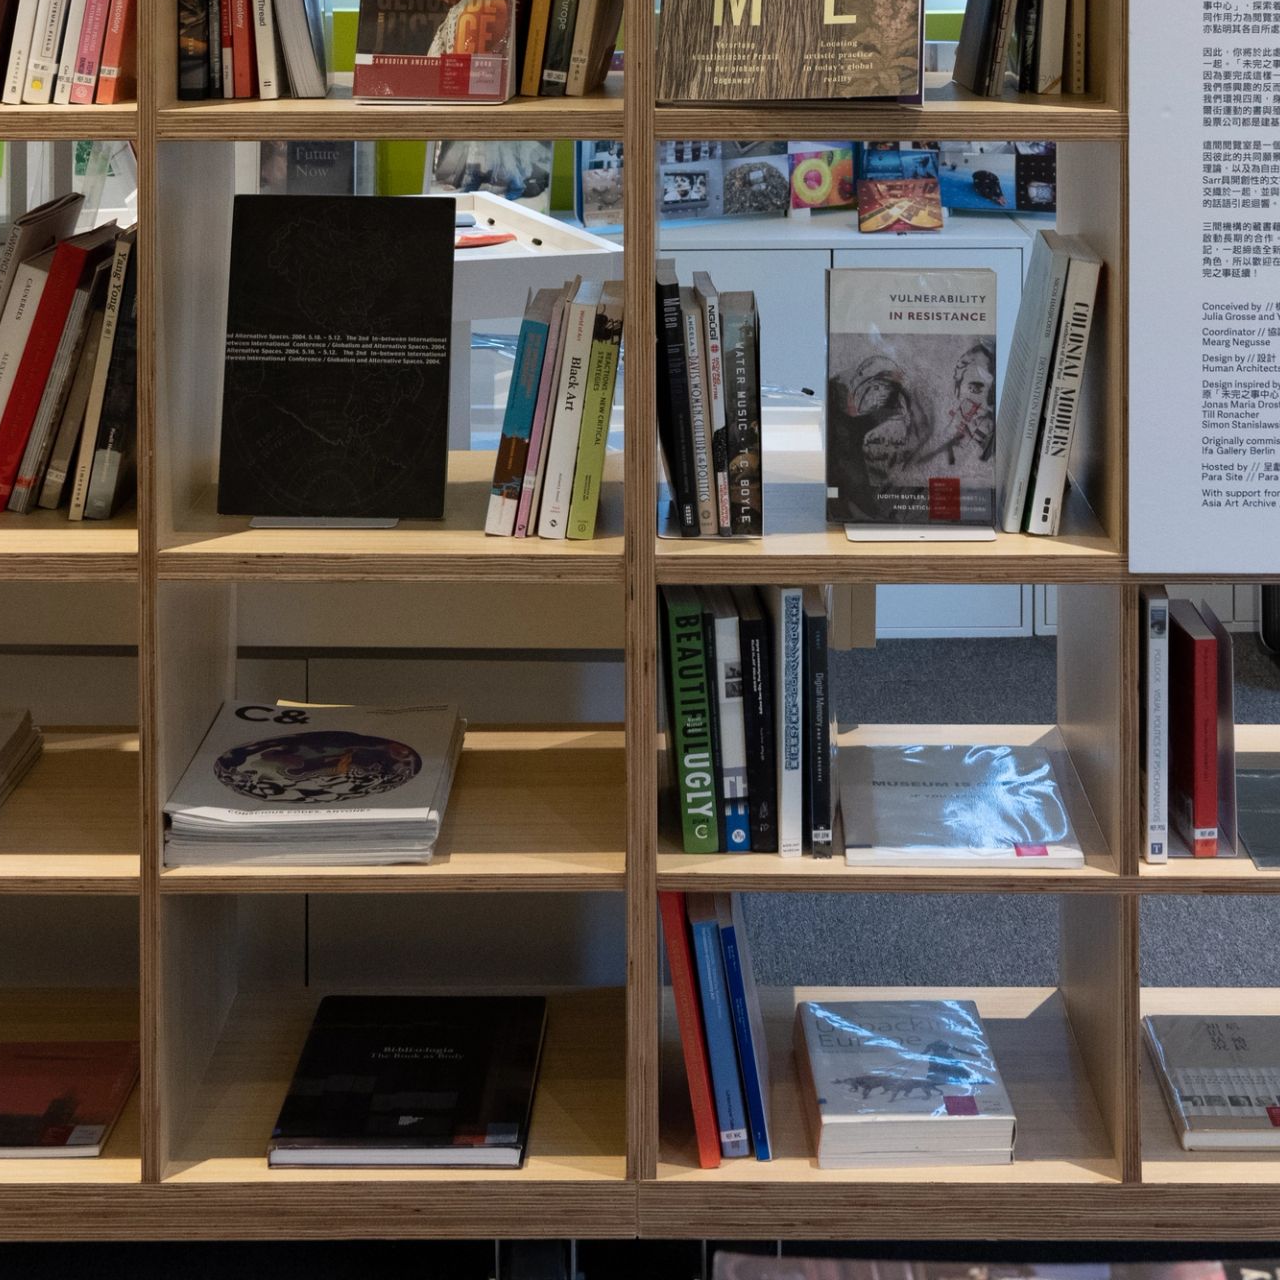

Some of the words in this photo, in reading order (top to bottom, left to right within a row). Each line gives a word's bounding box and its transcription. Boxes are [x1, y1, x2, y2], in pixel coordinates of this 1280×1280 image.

[889, 293, 987, 305] VULNERABILITY
[889, 311, 904, 322] IN
[907, 310, 987, 323] RESISTANCE
[1202, 312, 1223, 321] Julia
[1225, 313, 1256, 321] Grosse
[1258, 313, 1275, 321] and
[1063, 301, 1089, 385] COLONIAL
[1202, 338, 1230, 348] Mearg
[1233, 338, 1271, 348] Negusse
[570, 357, 582, 389] Black
[735, 342, 745, 385] WATER
[564, 391, 575, 412] Art
[737, 391, 747, 430] MUSIC
[1052, 388, 1077, 458] MODERN
[235, 706, 311, 725] C&
[684, 752, 713, 817] UGLY
